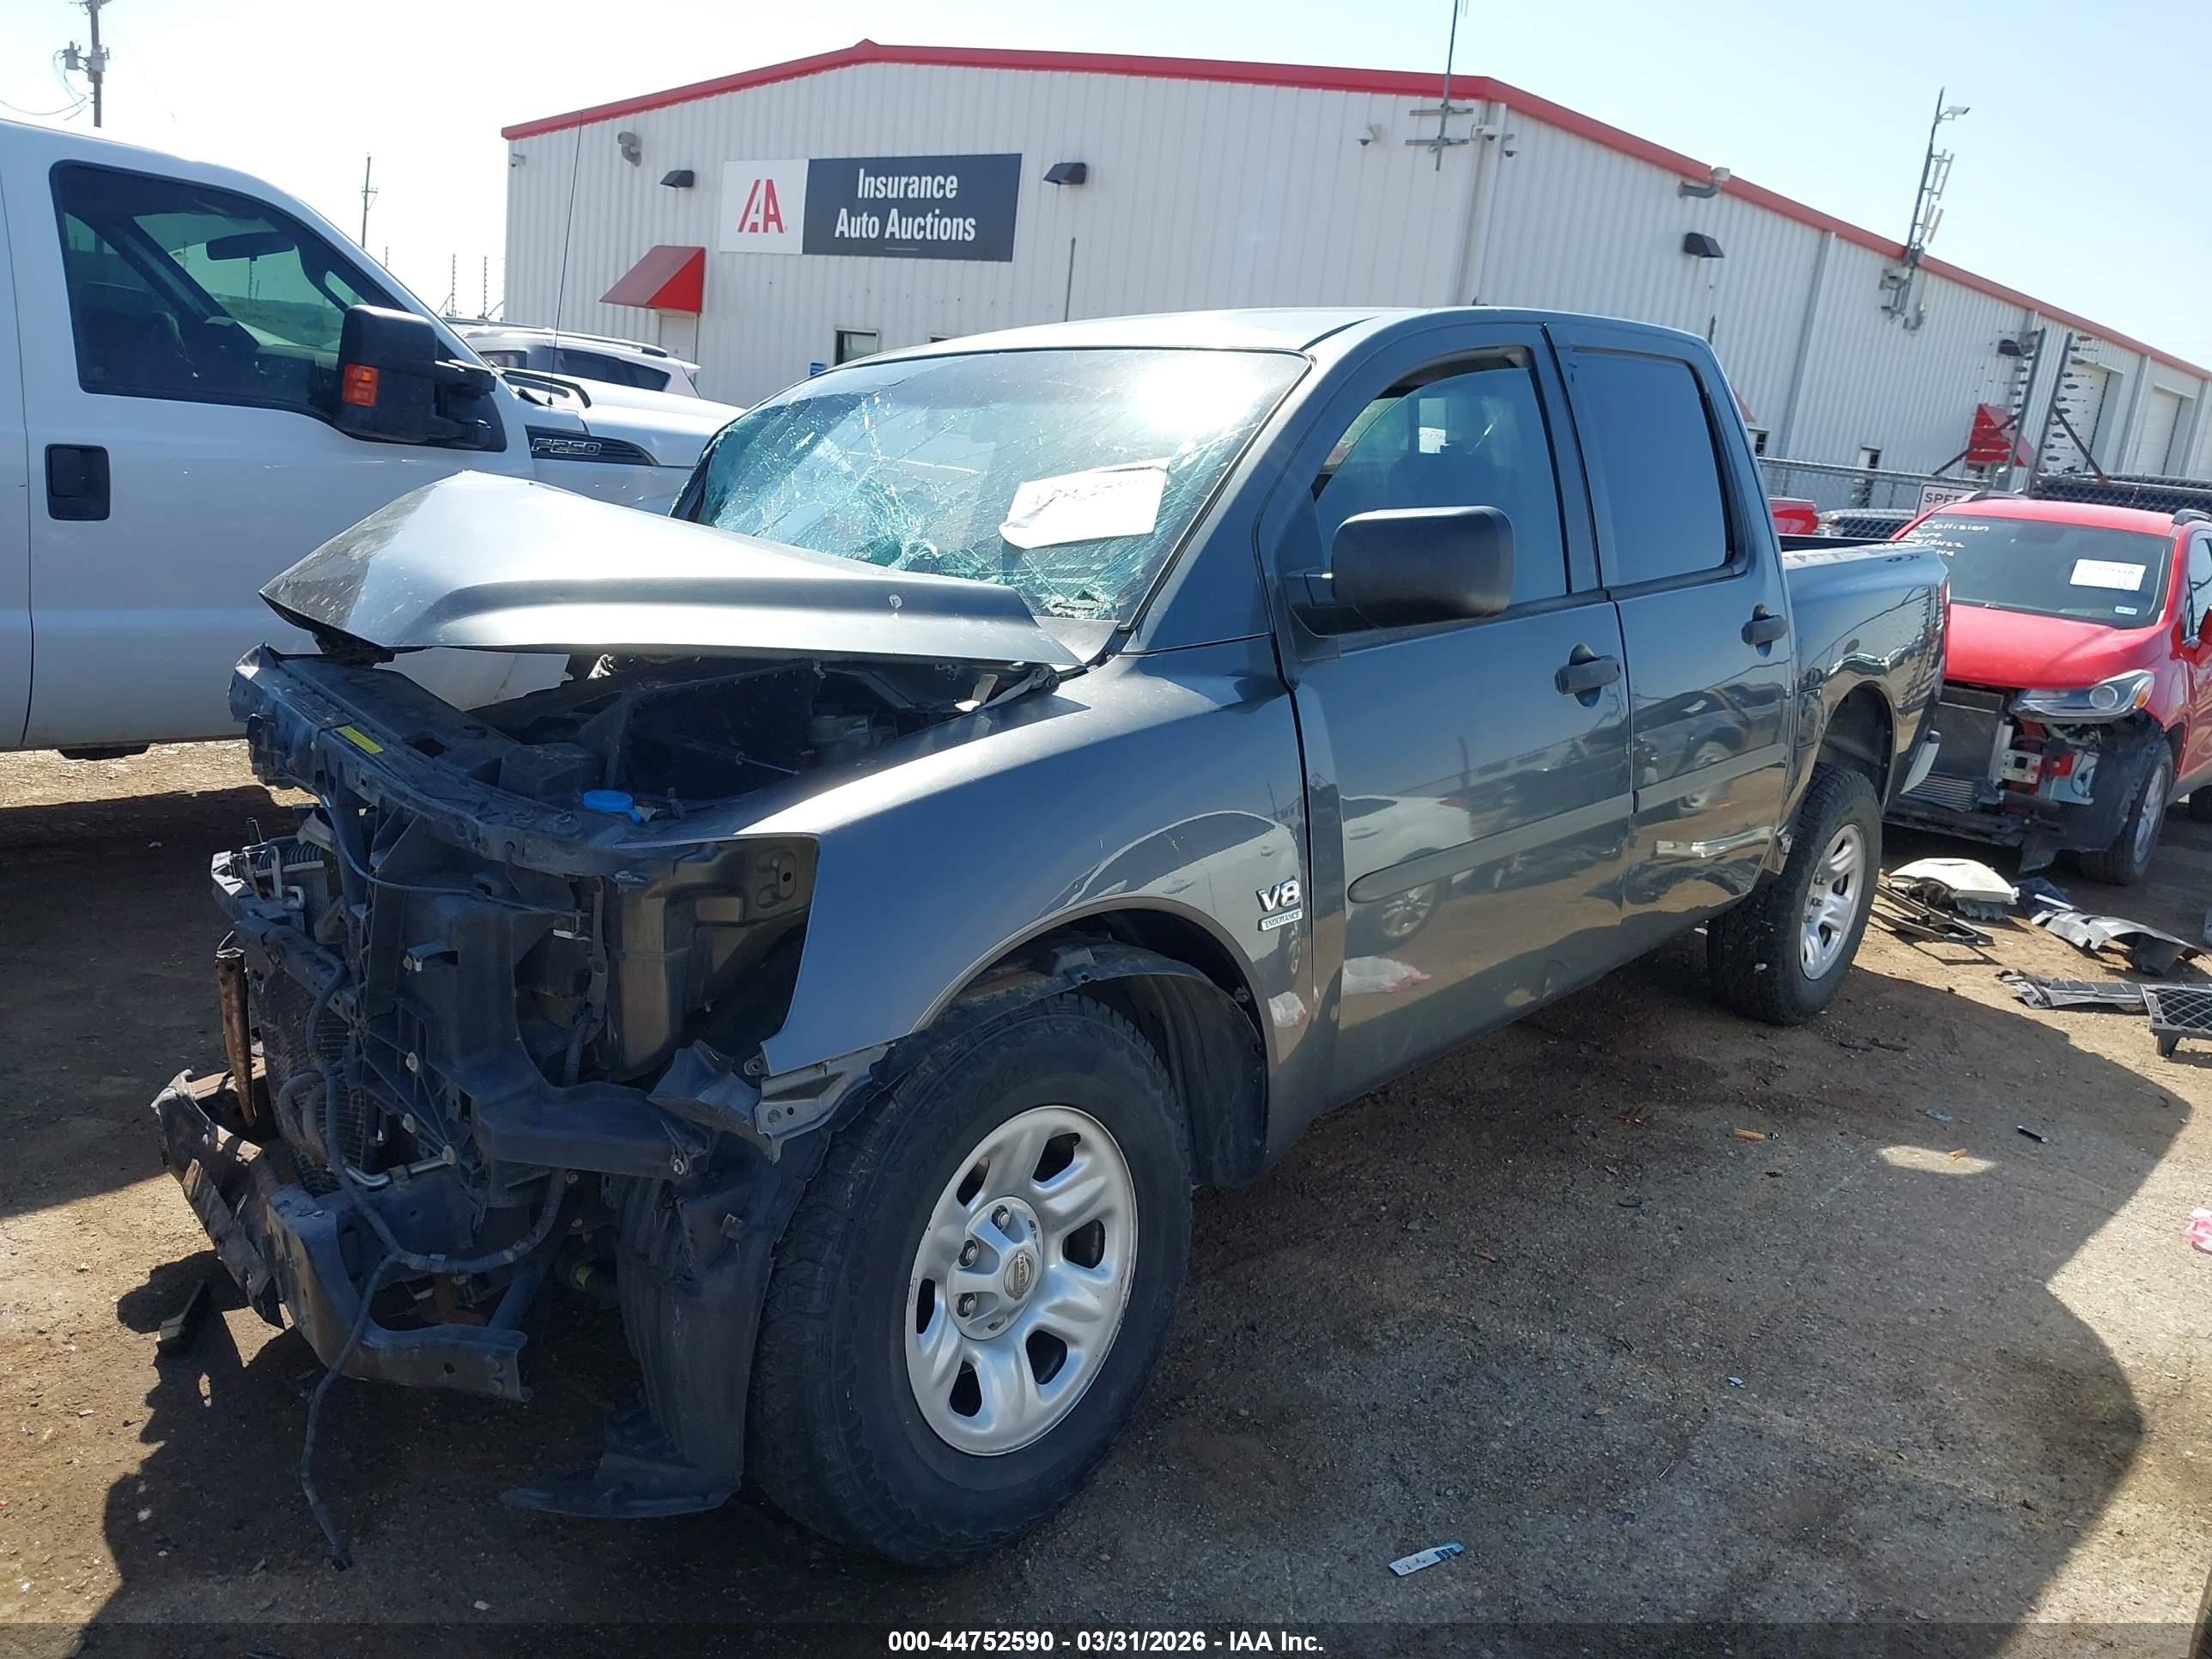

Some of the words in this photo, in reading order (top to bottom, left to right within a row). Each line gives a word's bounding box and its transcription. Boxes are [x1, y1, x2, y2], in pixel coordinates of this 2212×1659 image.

[857, 167, 959, 198] Insurance
[834, 208, 880, 239] Auto
[884, 208, 977, 241] Auctions
[531, 437, 602, 456] F250
[1918, 520, 1990, 532] Collision
[1255, 879, 1300, 912] V8
[1264, 910, 1301, 929] ENDURANCE
